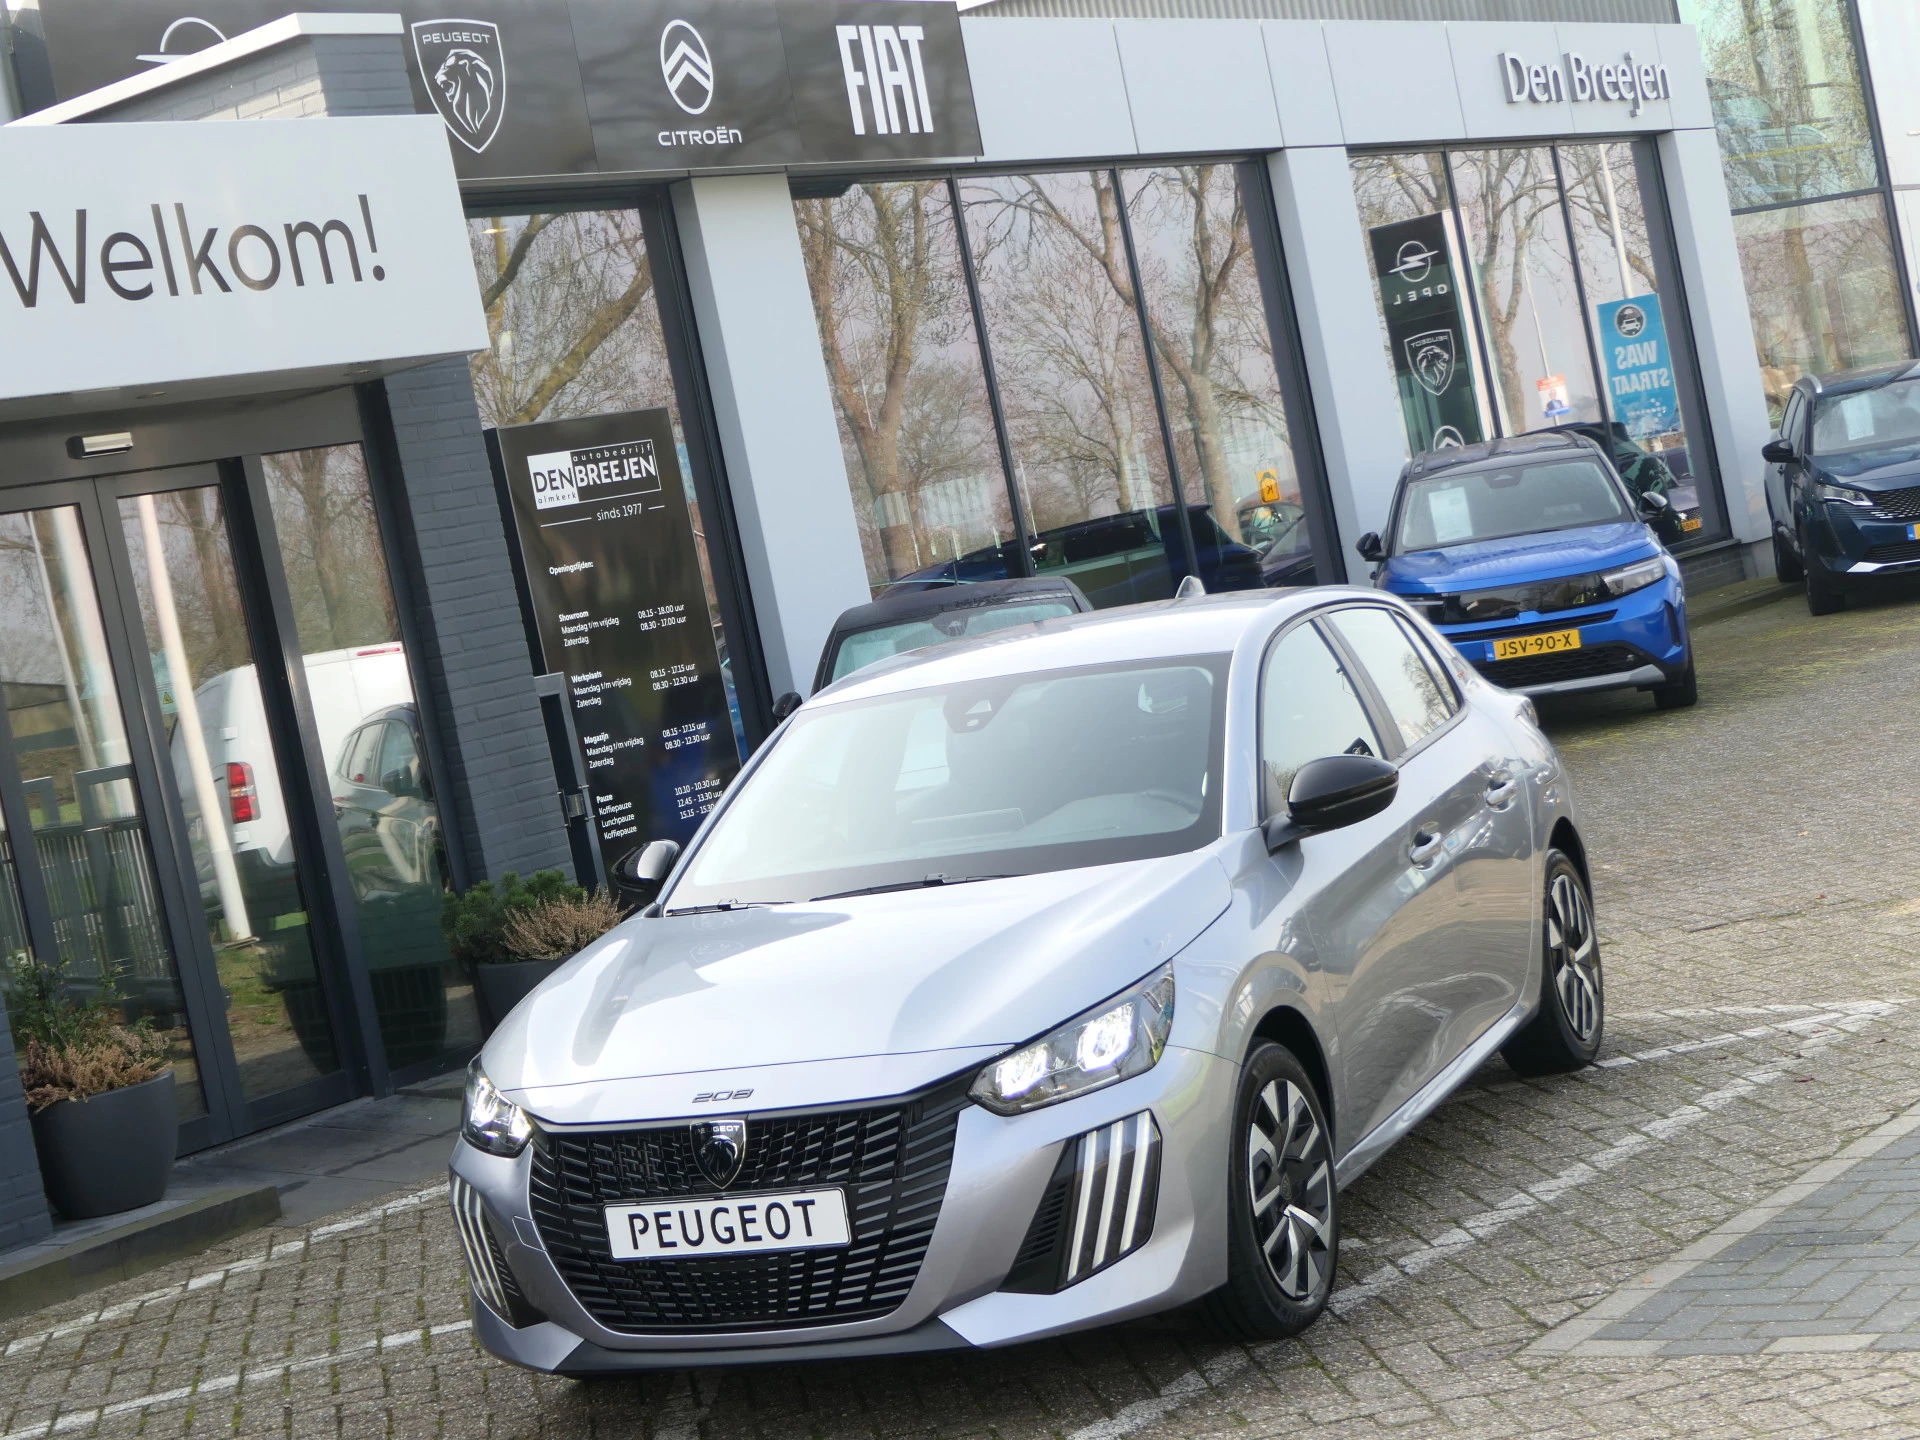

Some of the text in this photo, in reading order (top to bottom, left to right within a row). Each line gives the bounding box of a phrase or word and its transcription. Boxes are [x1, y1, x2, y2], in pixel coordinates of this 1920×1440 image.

[422, 31, 491, 45] PEUGEOT
[835, 25, 934, 135] FIAT
[1498, 51, 1672, 118] Den Breejen
[0, 194, 387, 309] Welkom!
[572, 443, 651, 462] autobedrijf
[533, 455, 656, 493] DEN BREEJEN
[596, 503, 642, 521] sinds 1977
[558, 610, 589, 622] Showroom
[638, 608, 654, 619] 08.15
[675, 603, 685, 612] uur
[561, 616, 619, 634] Maandag t/m vrijdag
[640, 621, 657, 631] 08.30
[661, 617, 676, 627] 17.00
[676, 615, 687, 624] uur
[563, 634, 589, 647] Zaterdag
[1500, 632, 1573, 657] JSV-90-X
[571, 671, 603, 684] Werkplaats
[650, 668, 666, 679] 08.15
[686, 663, 696, 672] uur
[574, 676, 632, 696] Maandag t/m vrijdag
[652, 681, 669, 691] 08.30
[673, 676, 688, 686] 12.30
[688, 674, 699, 683] uur
[576, 696, 602, 708] Zaterdag
[662, 727, 678, 738] 08.15
[696, 721, 707, 730] uur
[584, 732, 609, 745] Magazijn
[586, 736, 645, 756] Maandag t/m vrijdag
[665, 740, 681, 750] 08.30
[685, 735, 700, 745] 12.30
[700, 733, 711, 742] uur
[588, 756, 615, 769] Zaterdag
[675, 785, 691, 796] 10.10
[694, 780, 710, 791] 10.30
[710, 778, 721, 787] uur
[596, 794, 613, 804] Pauze
[677, 796, 693, 808] 12.45
[697, 792, 713, 803] 13.30
[713, 789, 723, 799] uur
[598, 801, 632, 816] Koffiepauze
[680, 808, 695, 820] 15.15
[601, 813, 635, 828] Lunchpauze
[603, 825, 638, 840] Koffiepauze
[691, 1088, 755, 1104] 208
[627, 1199, 816, 1250] PEUGEOT
